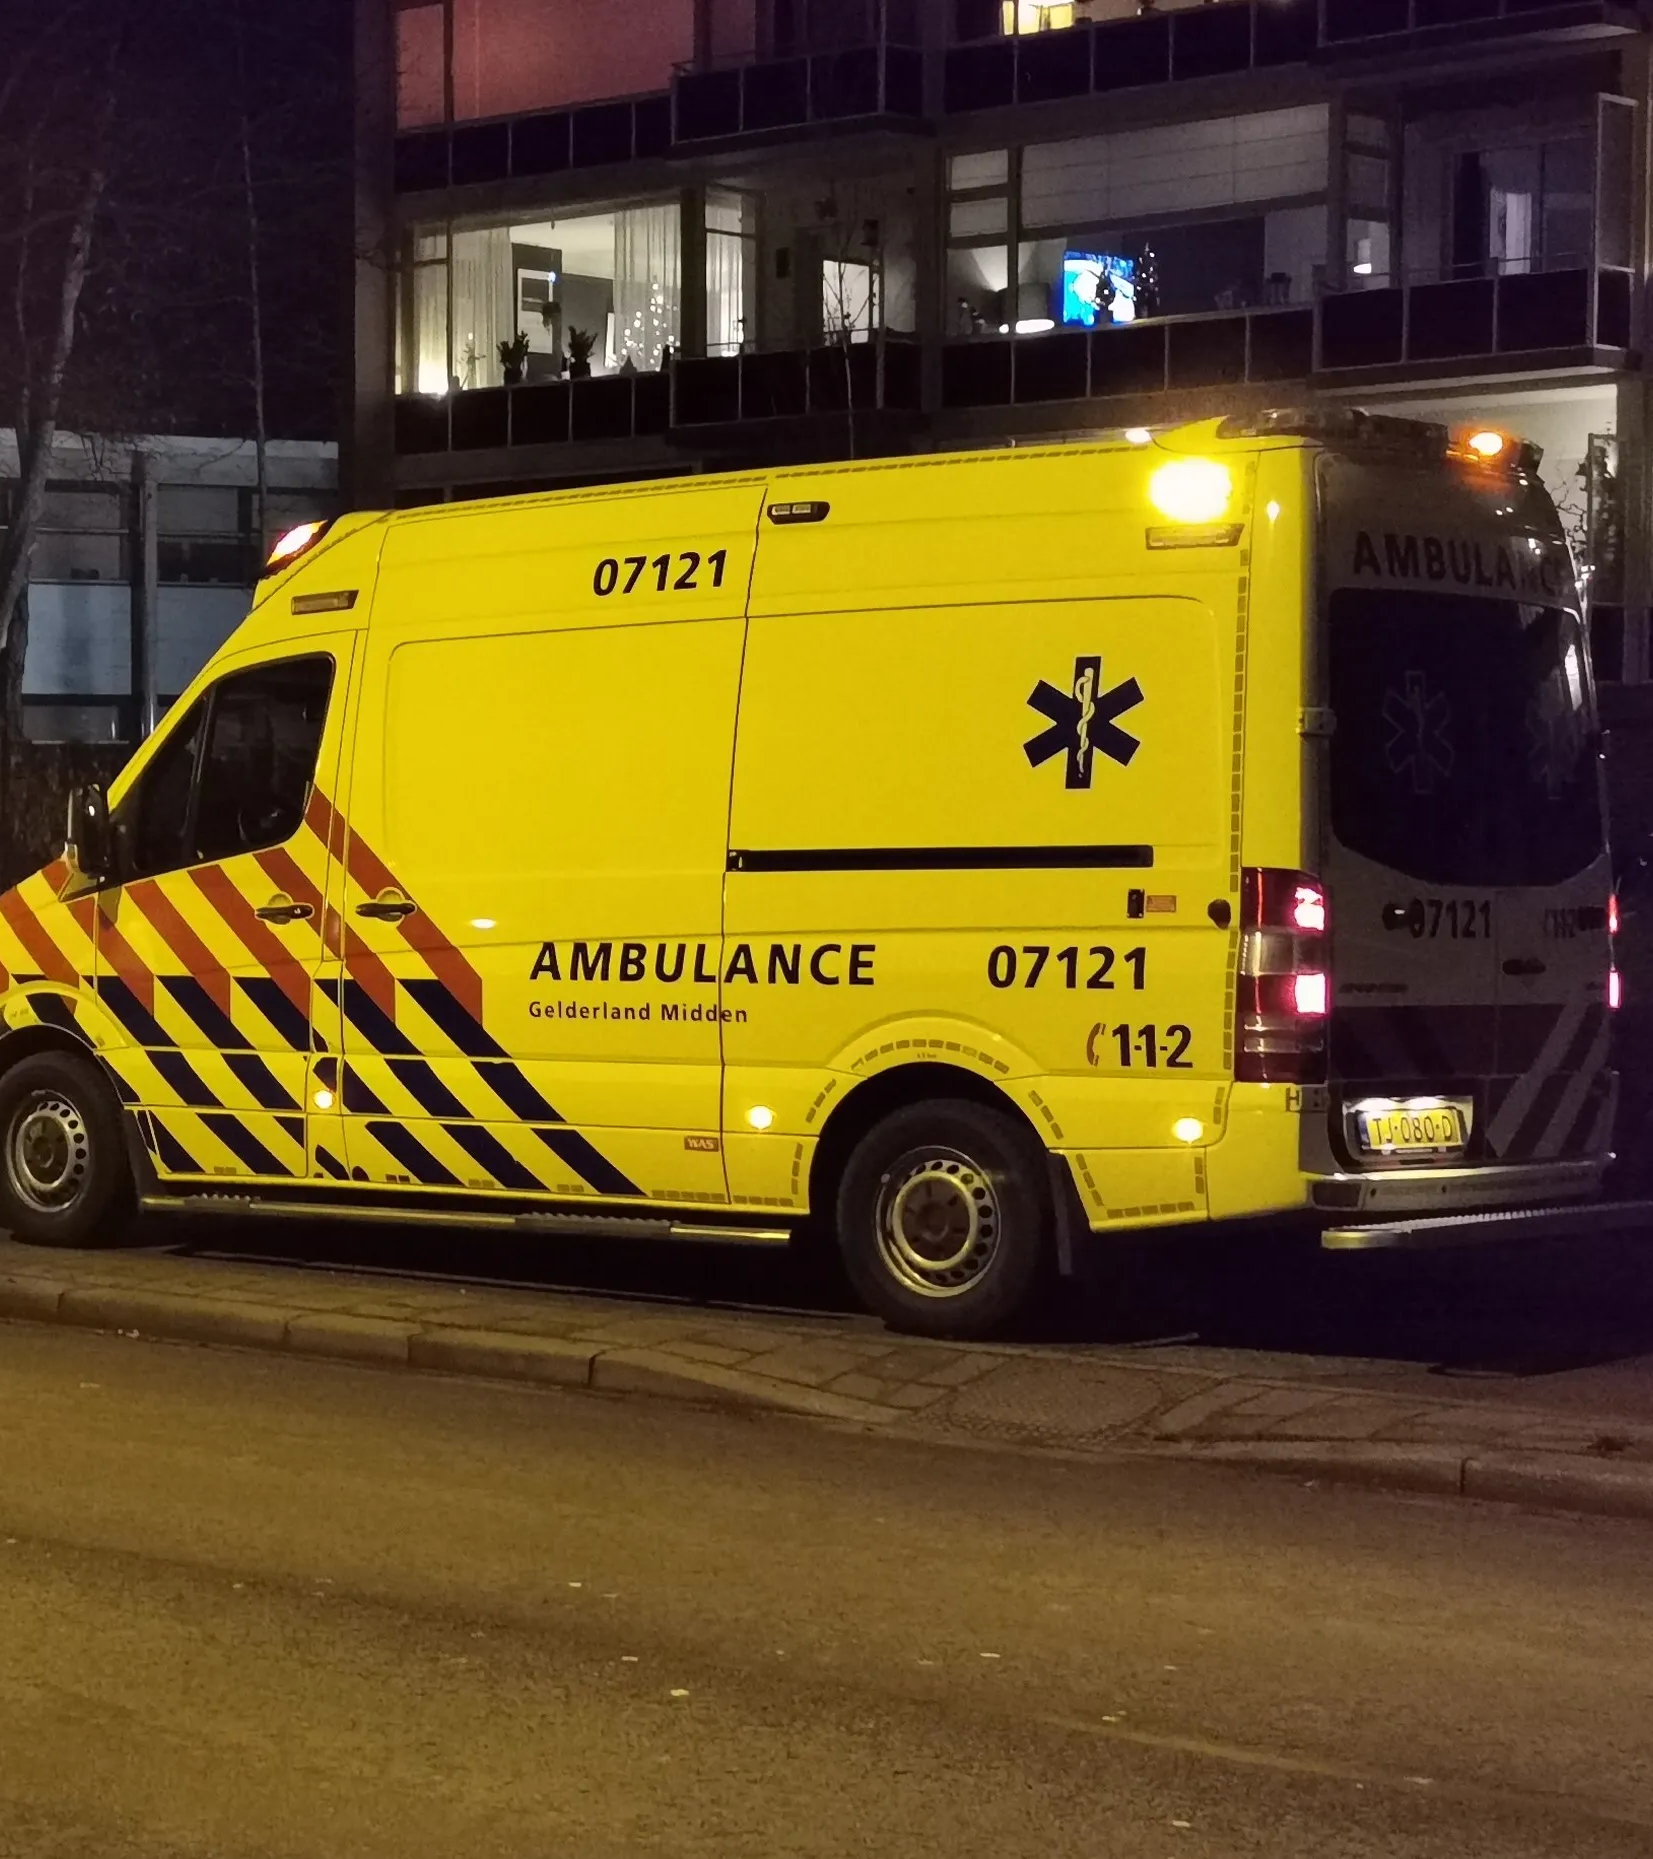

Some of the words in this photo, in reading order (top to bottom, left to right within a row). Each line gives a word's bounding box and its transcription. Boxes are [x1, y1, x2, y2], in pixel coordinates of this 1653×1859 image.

[593, 550, 727, 596] 07121
[529, 941, 876, 986] AMBULANCE
[987, 945, 1146, 990] 07121
[529, 1001, 650, 1021] Gelderland
[661, 1002, 747, 1023] Midden
